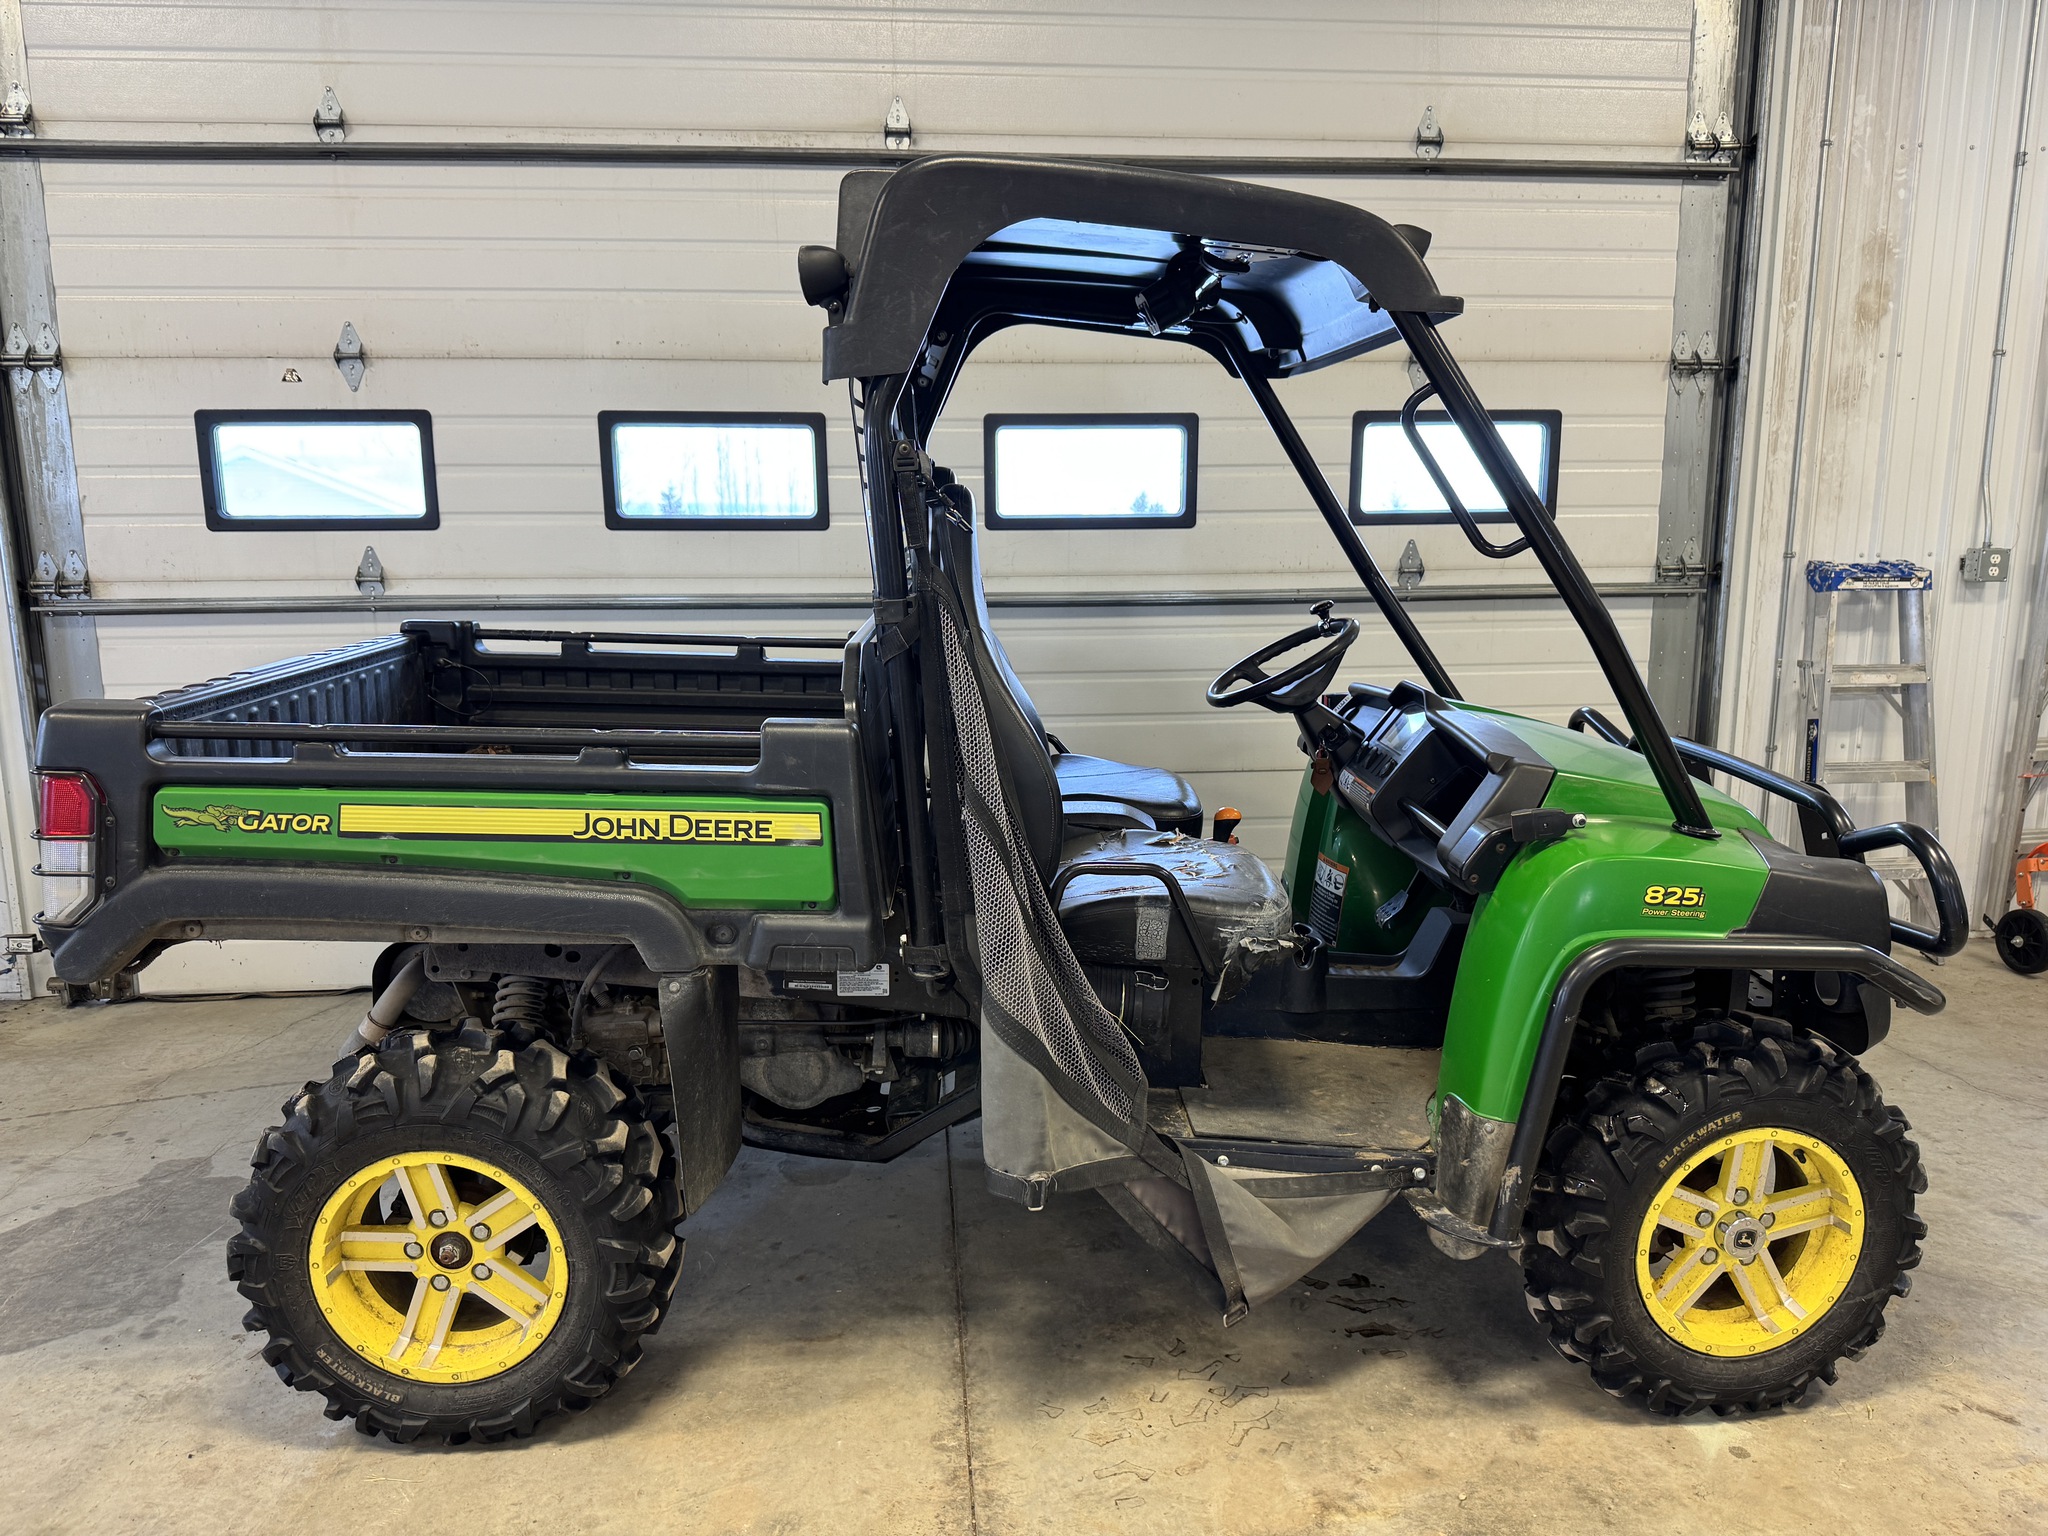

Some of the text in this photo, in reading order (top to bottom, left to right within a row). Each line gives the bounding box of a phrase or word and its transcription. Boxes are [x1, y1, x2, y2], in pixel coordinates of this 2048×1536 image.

[237, 809, 332, 834] GATOR
[573, 812, 774, 840] JOHN DEERE
[1644, 885, 1705, 906] 825i
[1642, 907, 1706, 918] Power Steering
[1658, 1110, 1742, 1169] BLACKWATER
[316, 1348, 401, 1404] BLACKWATER
